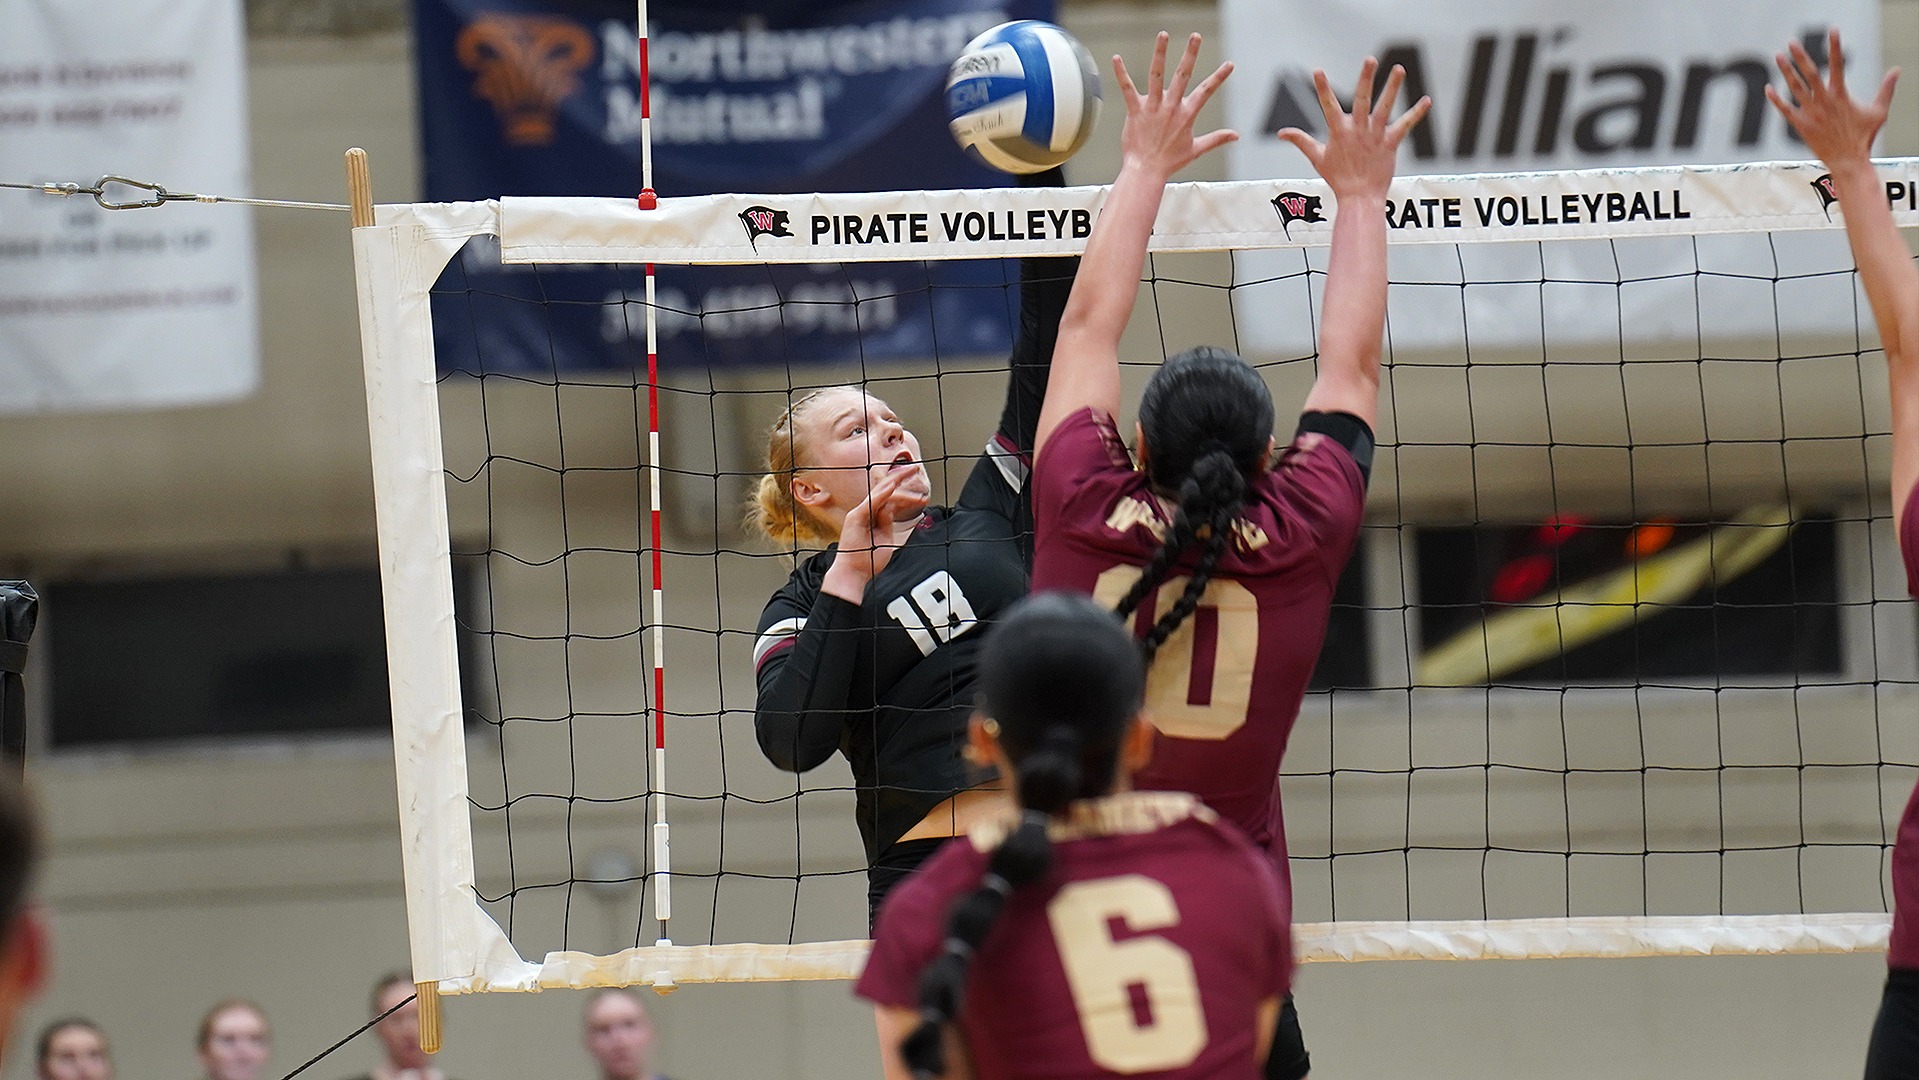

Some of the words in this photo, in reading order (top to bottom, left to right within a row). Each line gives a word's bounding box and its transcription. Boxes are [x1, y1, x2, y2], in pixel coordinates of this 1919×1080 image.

[606, 77, 825, 143] Mutual
[748, 211, 774, 231] W
[811, 213, 929, 245] PIRATE
[940, 209, 1093, 242] VOLLEYB
[1281, 197, 1307, 218] W
[1386, 198, 1462, 229] RATE
[1474, 190, 1691, 227] VOLLEYBALL
[886, 570, 978, 658] 18
[1046, 873, 1209, 1075] 6
